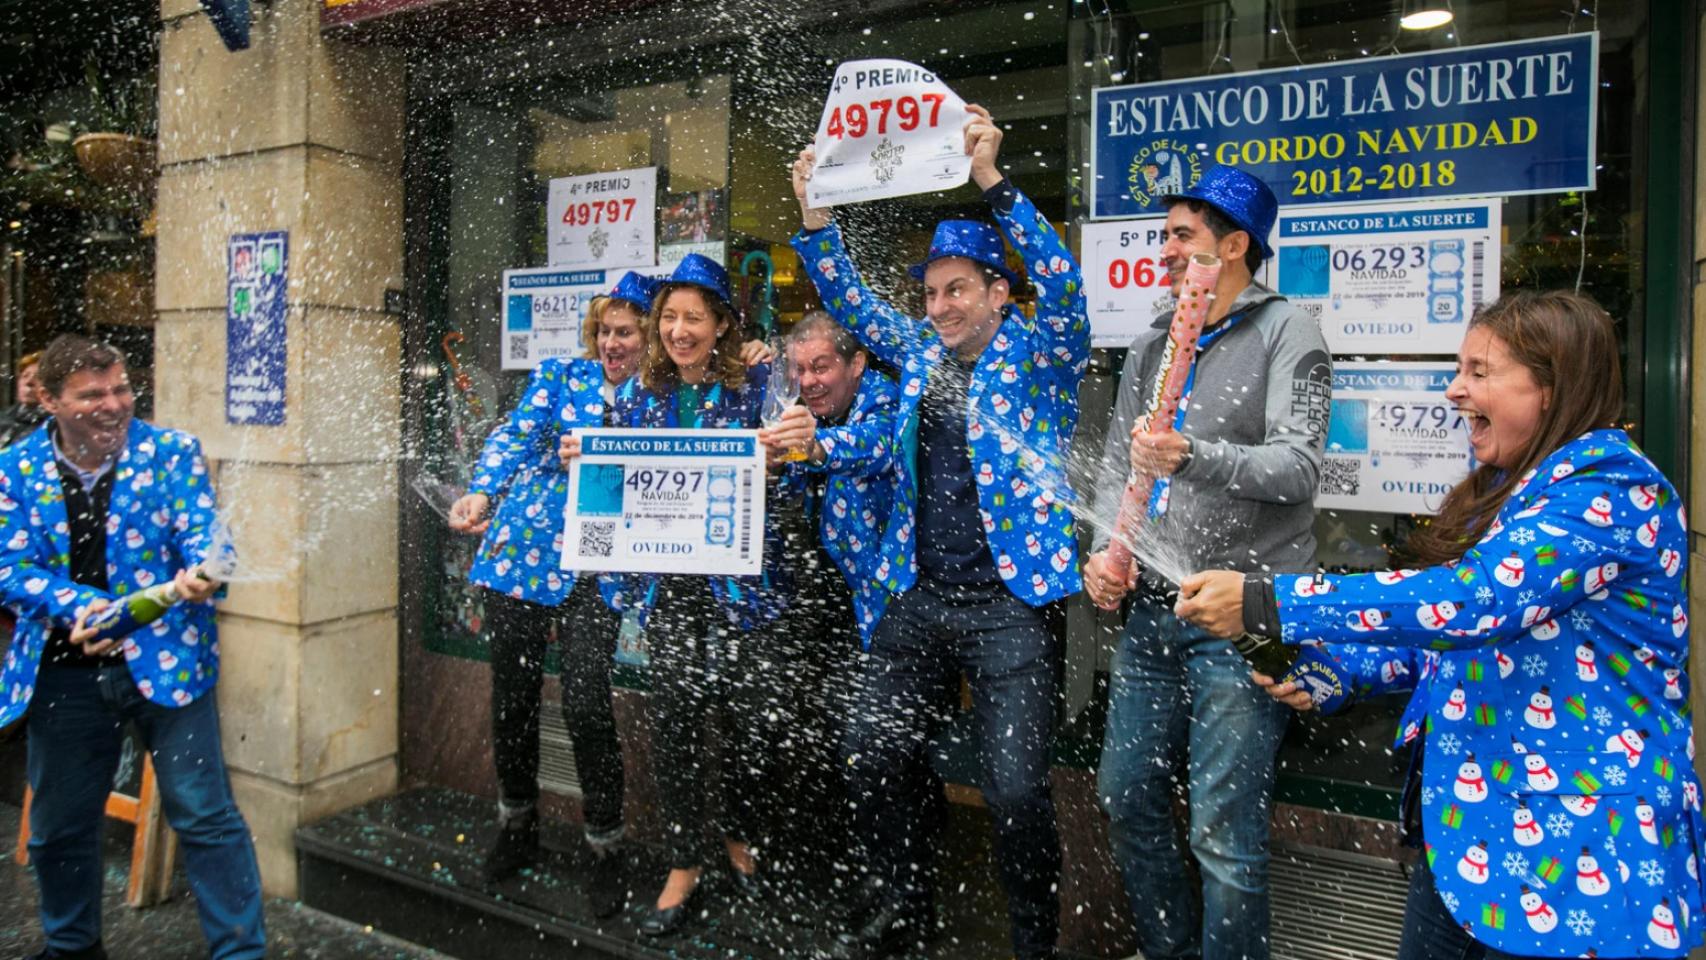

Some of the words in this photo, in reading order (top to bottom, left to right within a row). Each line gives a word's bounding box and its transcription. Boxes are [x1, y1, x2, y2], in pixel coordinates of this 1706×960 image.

[856, 68, 935, 90] PREMIO
[1108, 85, 1269, 137] ESTANCO
[1279, 78, 1330, 122] DE
[1341, 73, 1395, 116] LA
[1405, 51, 1574, 111] SUERTE
[826, 93, 946, 141] 49797
[1215, 133, 1346, 166] GORDO
[1356, 116, 1539, 157] NAVIDAD
[1128, 147, 1151, 207] ESTANCO
[1151, 139, 1169, 152] DE
[1171, 139, 1188, 154] LA
[1187, 152, 1202, 189] SUER
[1291, 160, 1456, 196] 2012-2018
[585, 177, 631, 193] PREMIO
[562, 198, 637, 226] 49797
[1291, 219, 1360, 233] ESTANCO
[1363, 217, 1385, 230] DE
[1388, 215, 1409, 228] LA
[1412, 212, 1476, 227] SUERTE
[1120, 231, 1139, 247] 5º
[1332, 246, 1426, 272] 06293
[1108, 257, 1172, 289] 062
[1350, 269, 1407, 281] NAVIDAD
[534, 296, 578, 313] 66212
[1437, 302, 1450, 311] 20
[1343, 321, 1414, 335] OVIEDO
[1332, 374, 1399, 387] ESTANCO
[1403, 374, 1426, 386] DE
[1429, 374, 1449, 386] LA
[1291, 381, 1308, 417] THE
[1306, 382, 1322, 449] NORTH
[1321, 385, 1331, 436] FACE
[1371, 405, 1461, 430] 49797
[1390, 428, 1448, 439] NAVIDAD
[592, 439, 651, 452] ESTANCO
[653, 441, 673, 452] DE
[674, 441, 692, 452] LA
[694, 441, 746, 453] SUERTE
[626, 469, 704, 492] 49797
[1382, 480, 1453, 495] OVIEDO
[641, 490, 689, 501] NAVIDAD
[633, 542, 693, 555] OVIEDO
[1311, 661, 1343, 696] SUERTE
